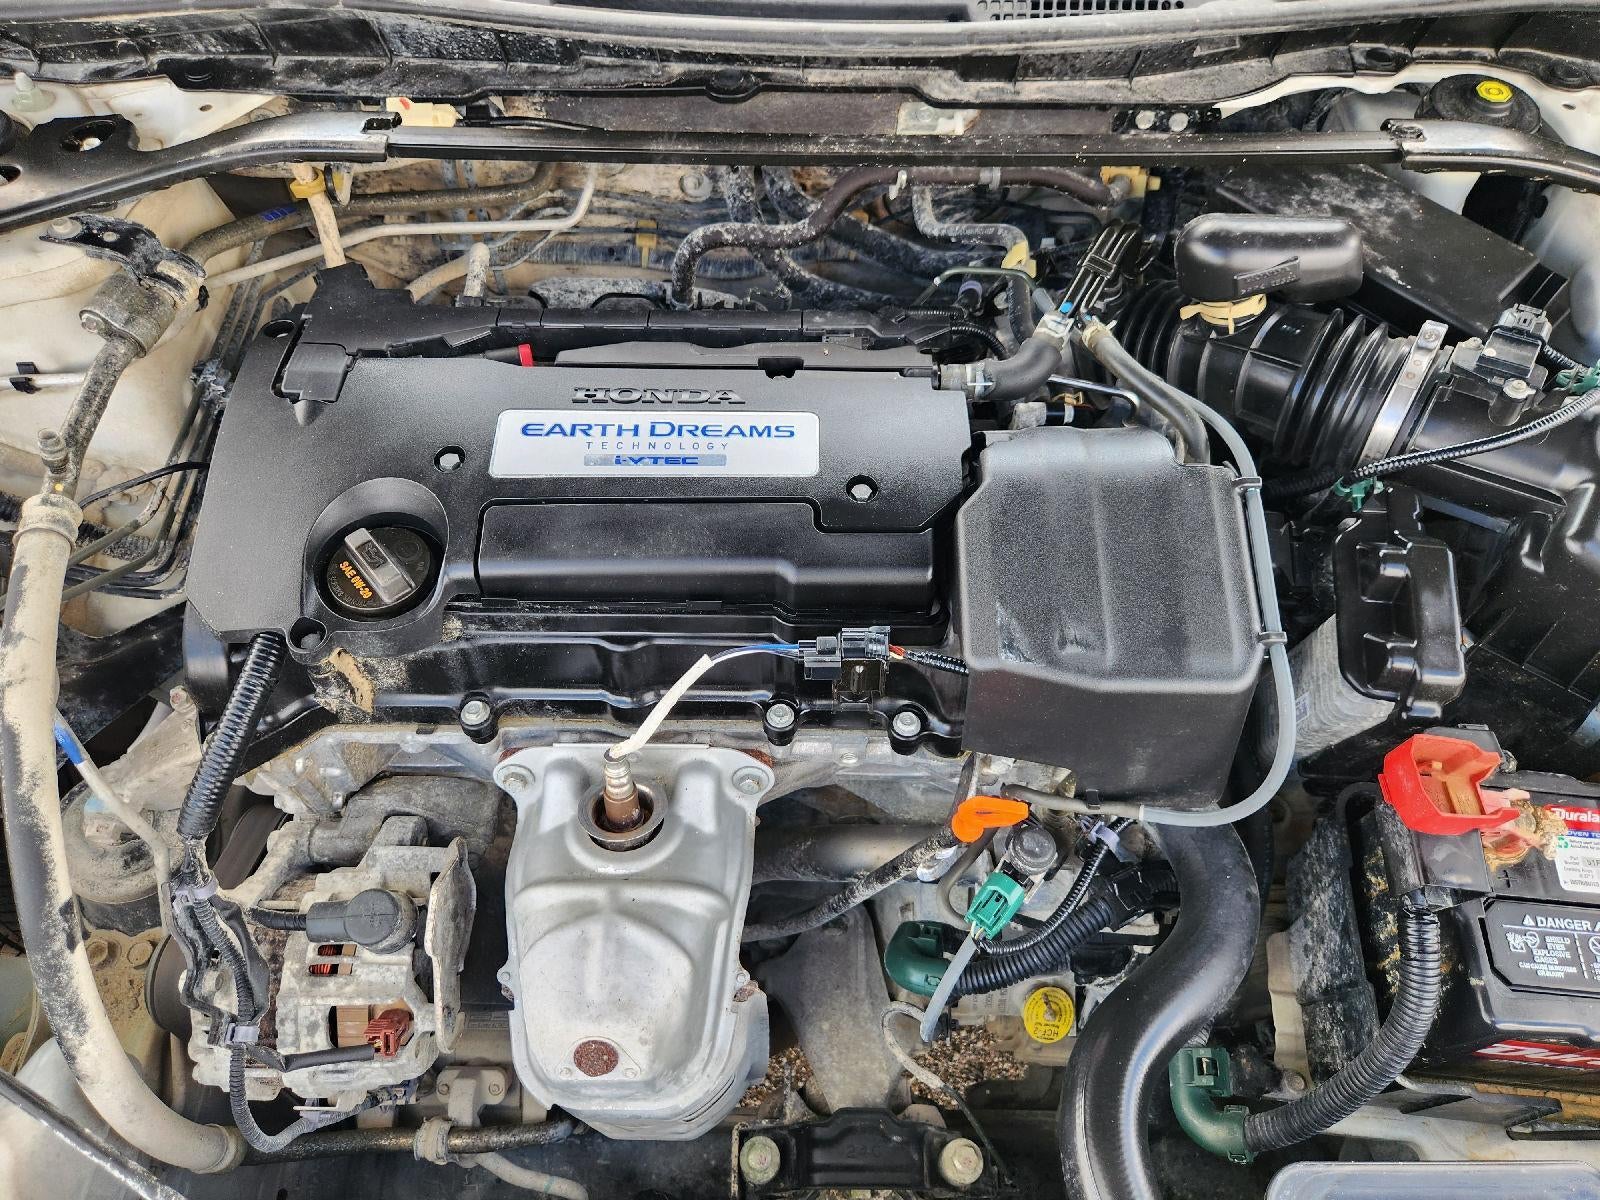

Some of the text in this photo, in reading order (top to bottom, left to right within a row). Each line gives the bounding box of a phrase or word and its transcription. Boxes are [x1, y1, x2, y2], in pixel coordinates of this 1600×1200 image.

[571, 387, 746, 404] HONDA
[521, 421, 795, 438] EARTH DREAMS
[585, 441, 729, 450] TECHNOLOGY
[614, 454, 699, 466] i-VTEC
[339, 561, 357, 578] SAE
[1536, 915, 1592, 931] DANGER
[1545, 935, 1571, 945] SHIELD
[1533, 948, 1571, 960] EXPLOSIVE
